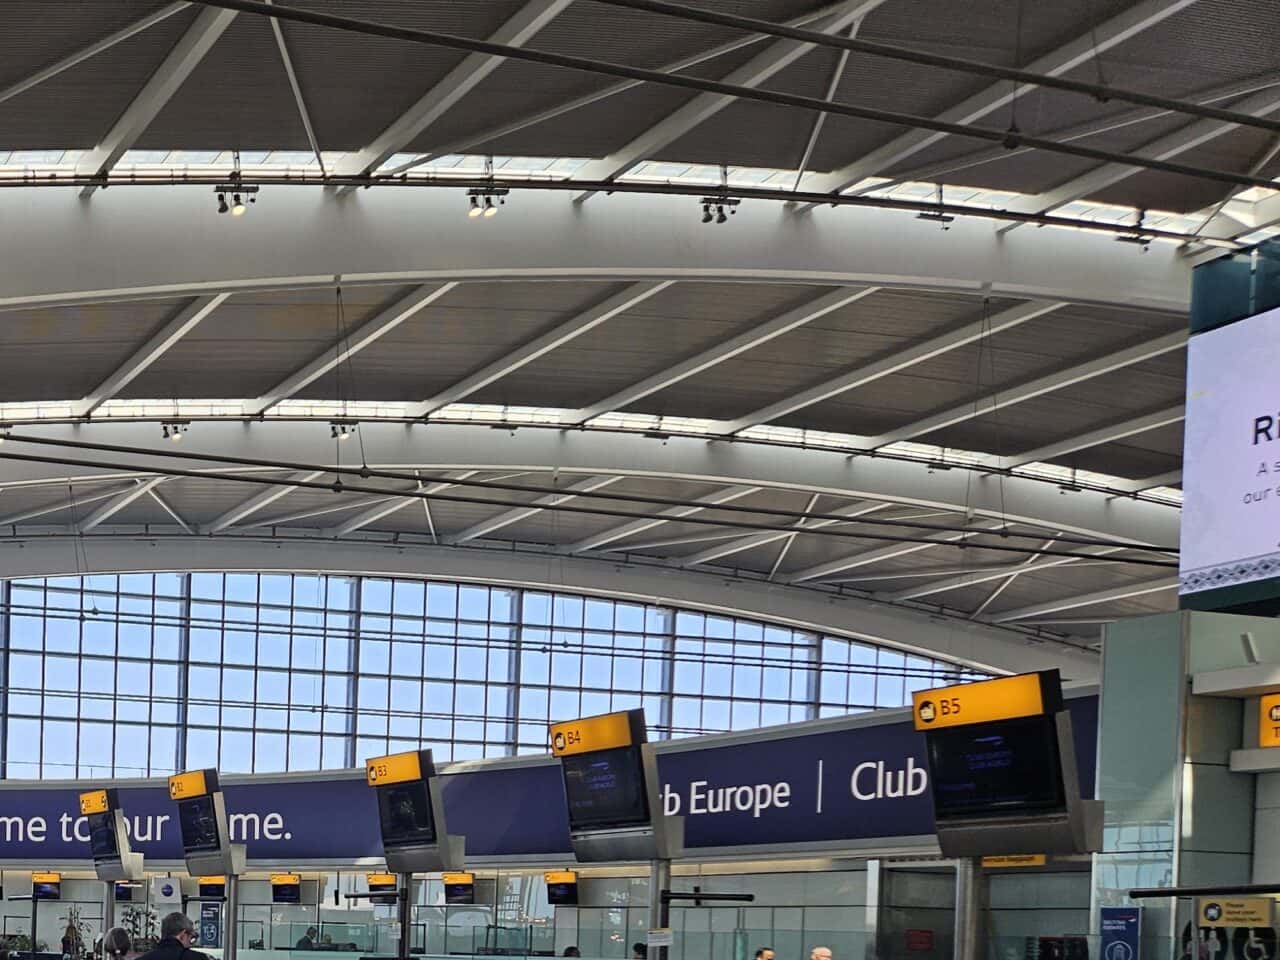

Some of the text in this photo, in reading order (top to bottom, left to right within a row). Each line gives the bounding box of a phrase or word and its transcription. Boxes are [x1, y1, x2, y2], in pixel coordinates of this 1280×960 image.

[940, 698, 961, 716] B5
[567, 730, 581, 745] B4
[377, 765, 388, 778] B3
[850, 757, 929, 801] Club
[689, 781, 791, 818] Europe
